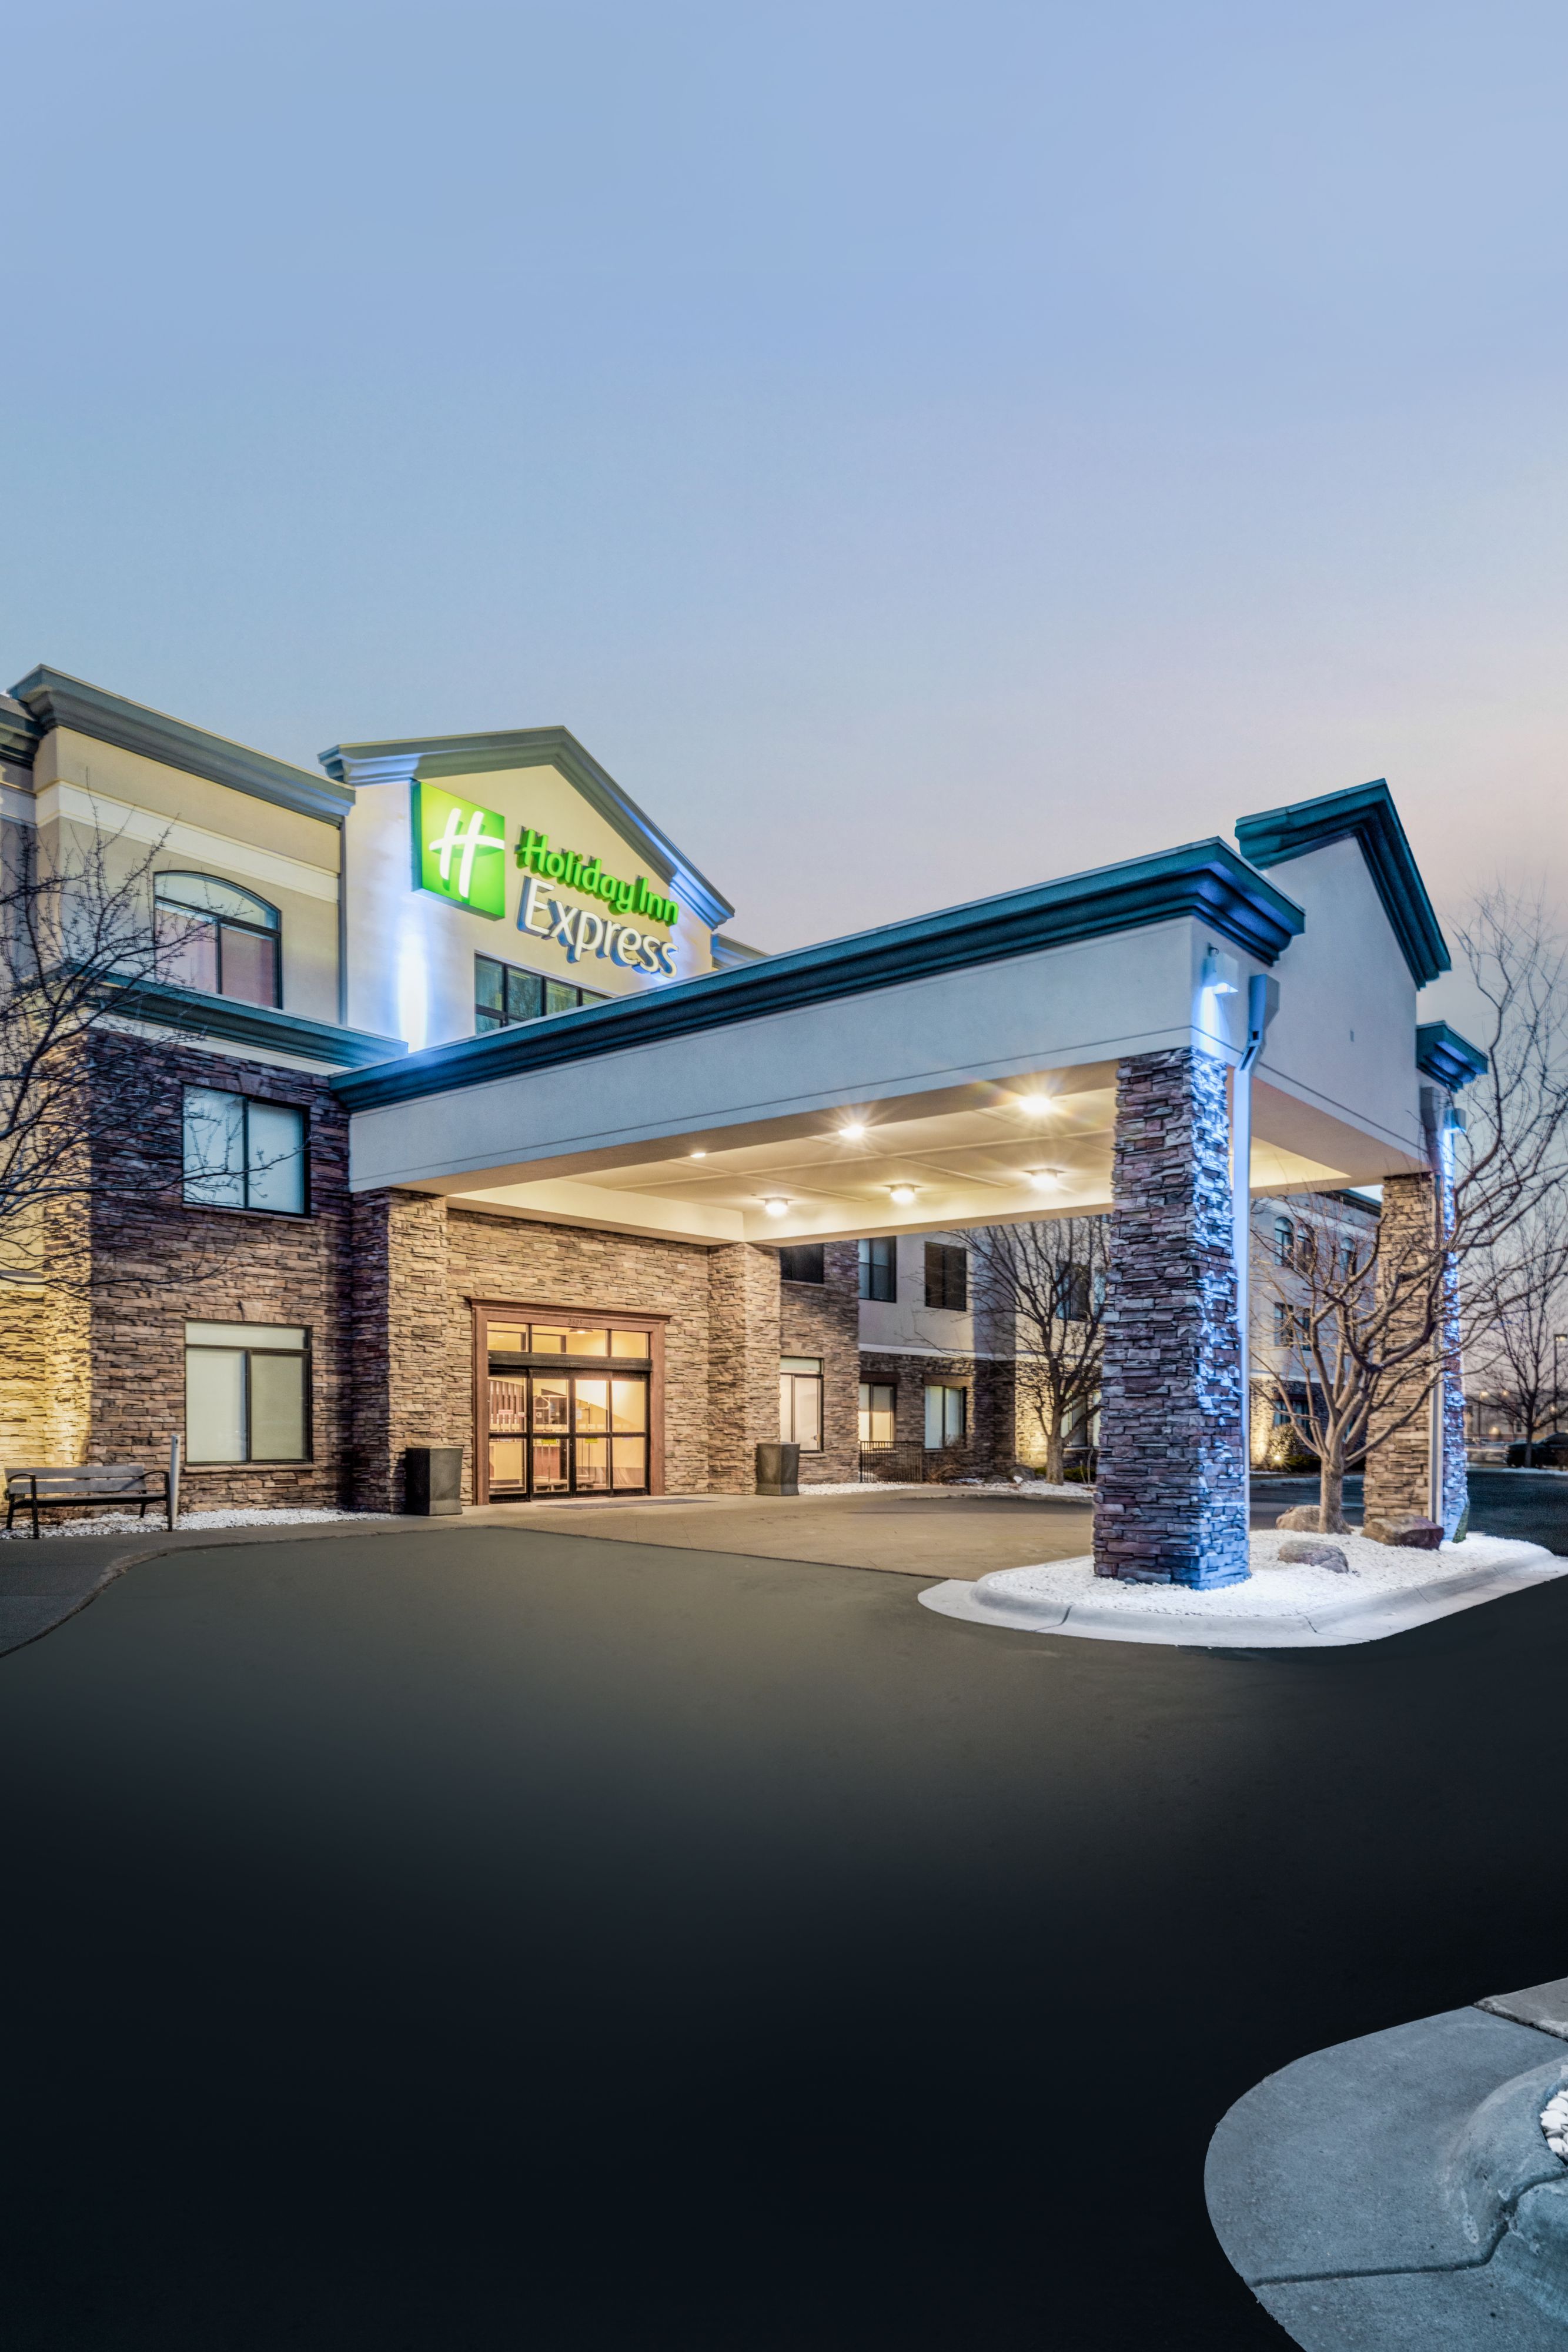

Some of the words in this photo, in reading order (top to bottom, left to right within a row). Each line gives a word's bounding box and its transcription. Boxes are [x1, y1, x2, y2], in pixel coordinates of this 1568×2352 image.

[520, 828, 635, 914] Holiday
[637, 876, 679, 926] Inn
[522, 876, 679, 978] Express
